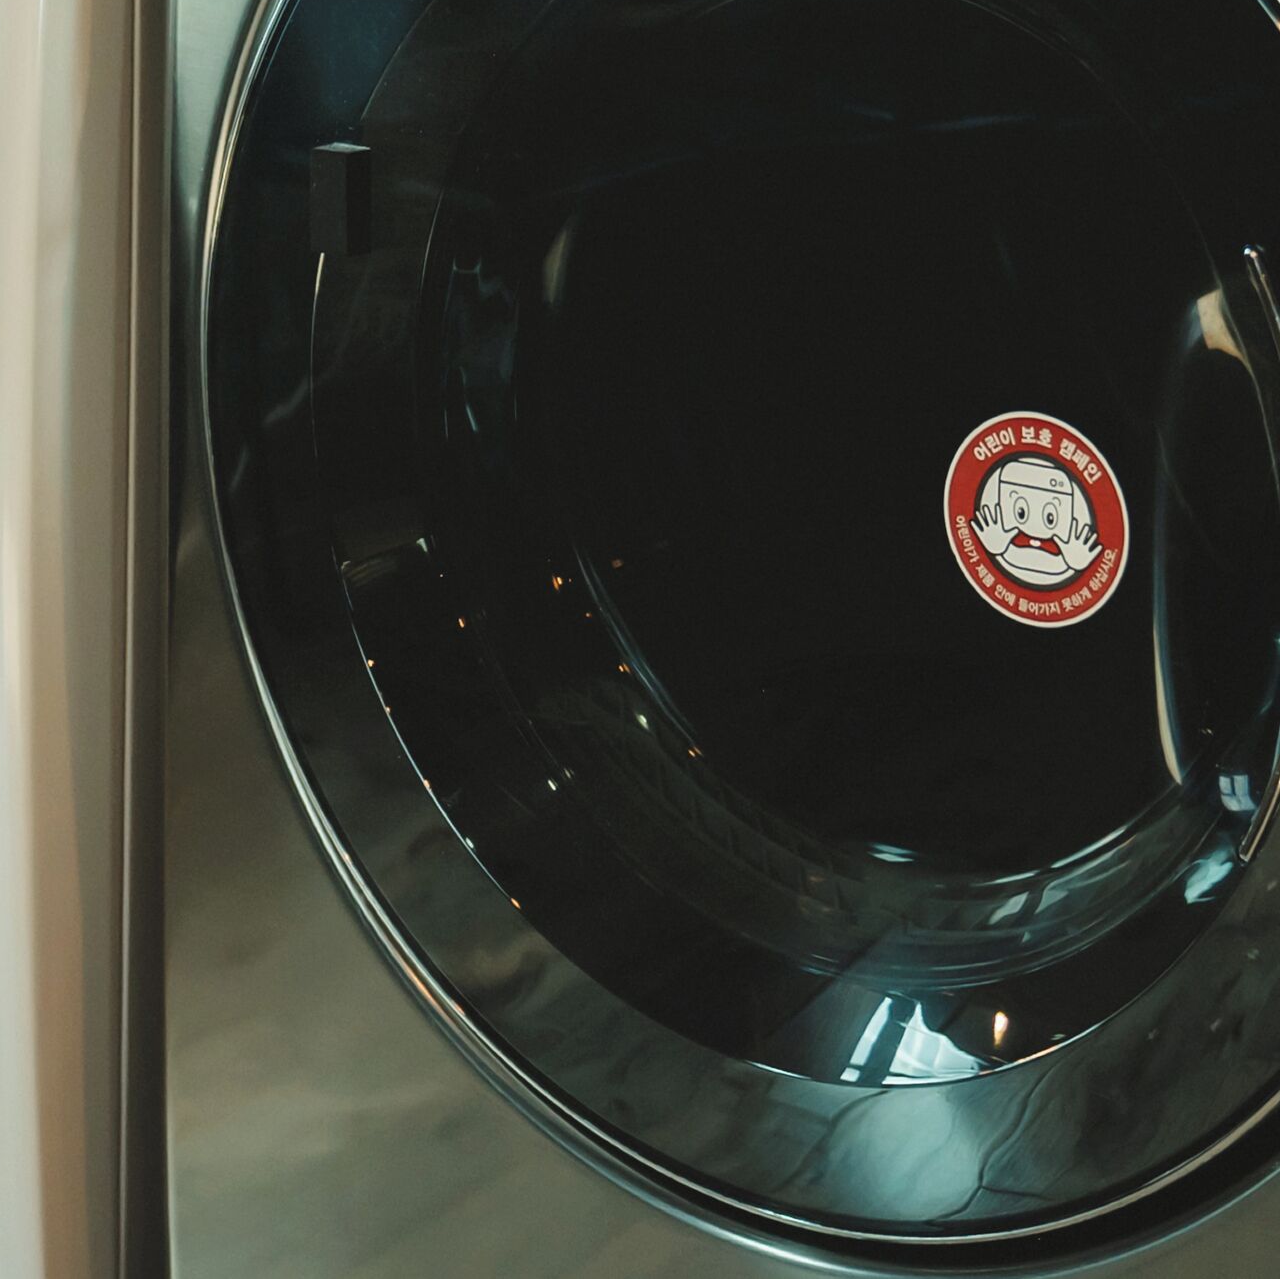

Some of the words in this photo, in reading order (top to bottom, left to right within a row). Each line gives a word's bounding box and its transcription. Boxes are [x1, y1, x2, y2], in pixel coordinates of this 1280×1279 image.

[973, 427, 1016, 462] 어린이
[1021, 426, 1053, 448] 보호
[1059, 437, 1102, 484] 캠페인
[956, 515, 980, 564] 어린이가
[975, 562, 995, 588] 제품
[994, 583, 1016, 606] 안에
[1018, 597, 1061, 616] 들어가지
[1063, 588, 1092, 615] 못하게
[1090, 548, 1118, 592] 하십시오.
